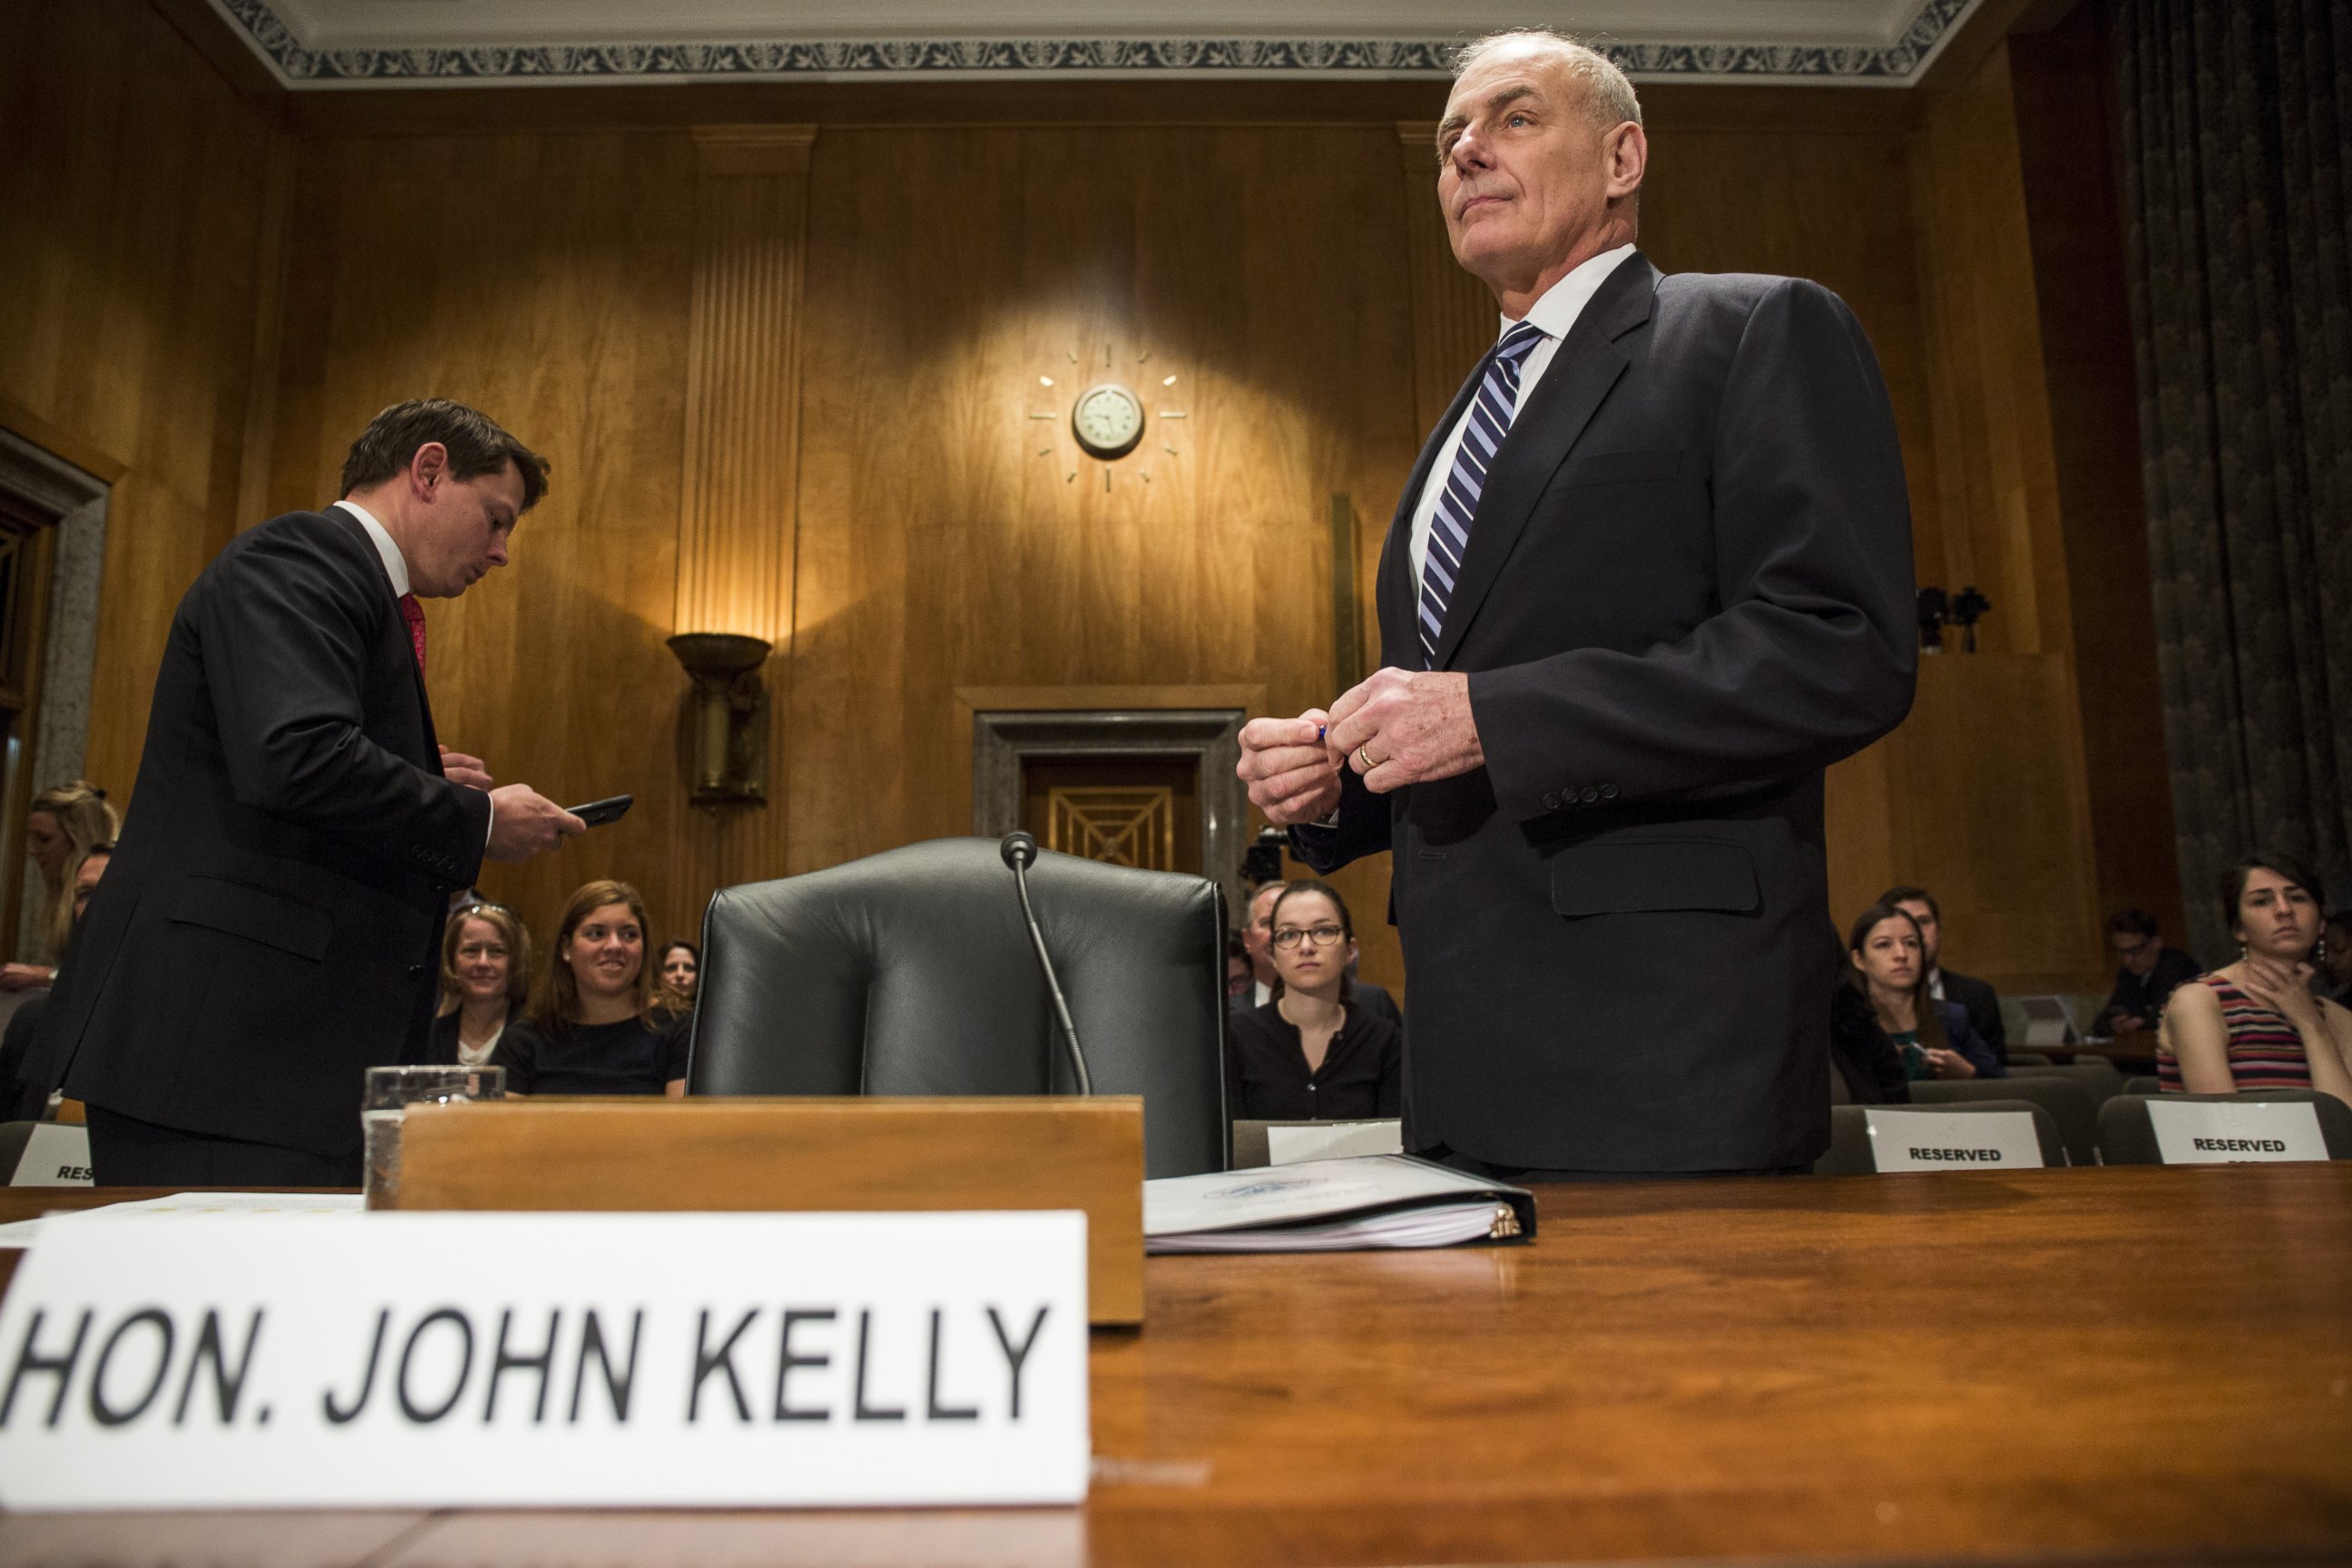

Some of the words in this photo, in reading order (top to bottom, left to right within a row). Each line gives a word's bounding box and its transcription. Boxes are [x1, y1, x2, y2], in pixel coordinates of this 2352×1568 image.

[2193, 1138, 2286, 1152] RESERVED
[1908, 1147, 2002, 1161] RESERVED
[0, 1307, 275, 1427] HON.
[322, 1305, 643, 1425] JOHN
[686, 1304, 1050, 1423] KELLY
